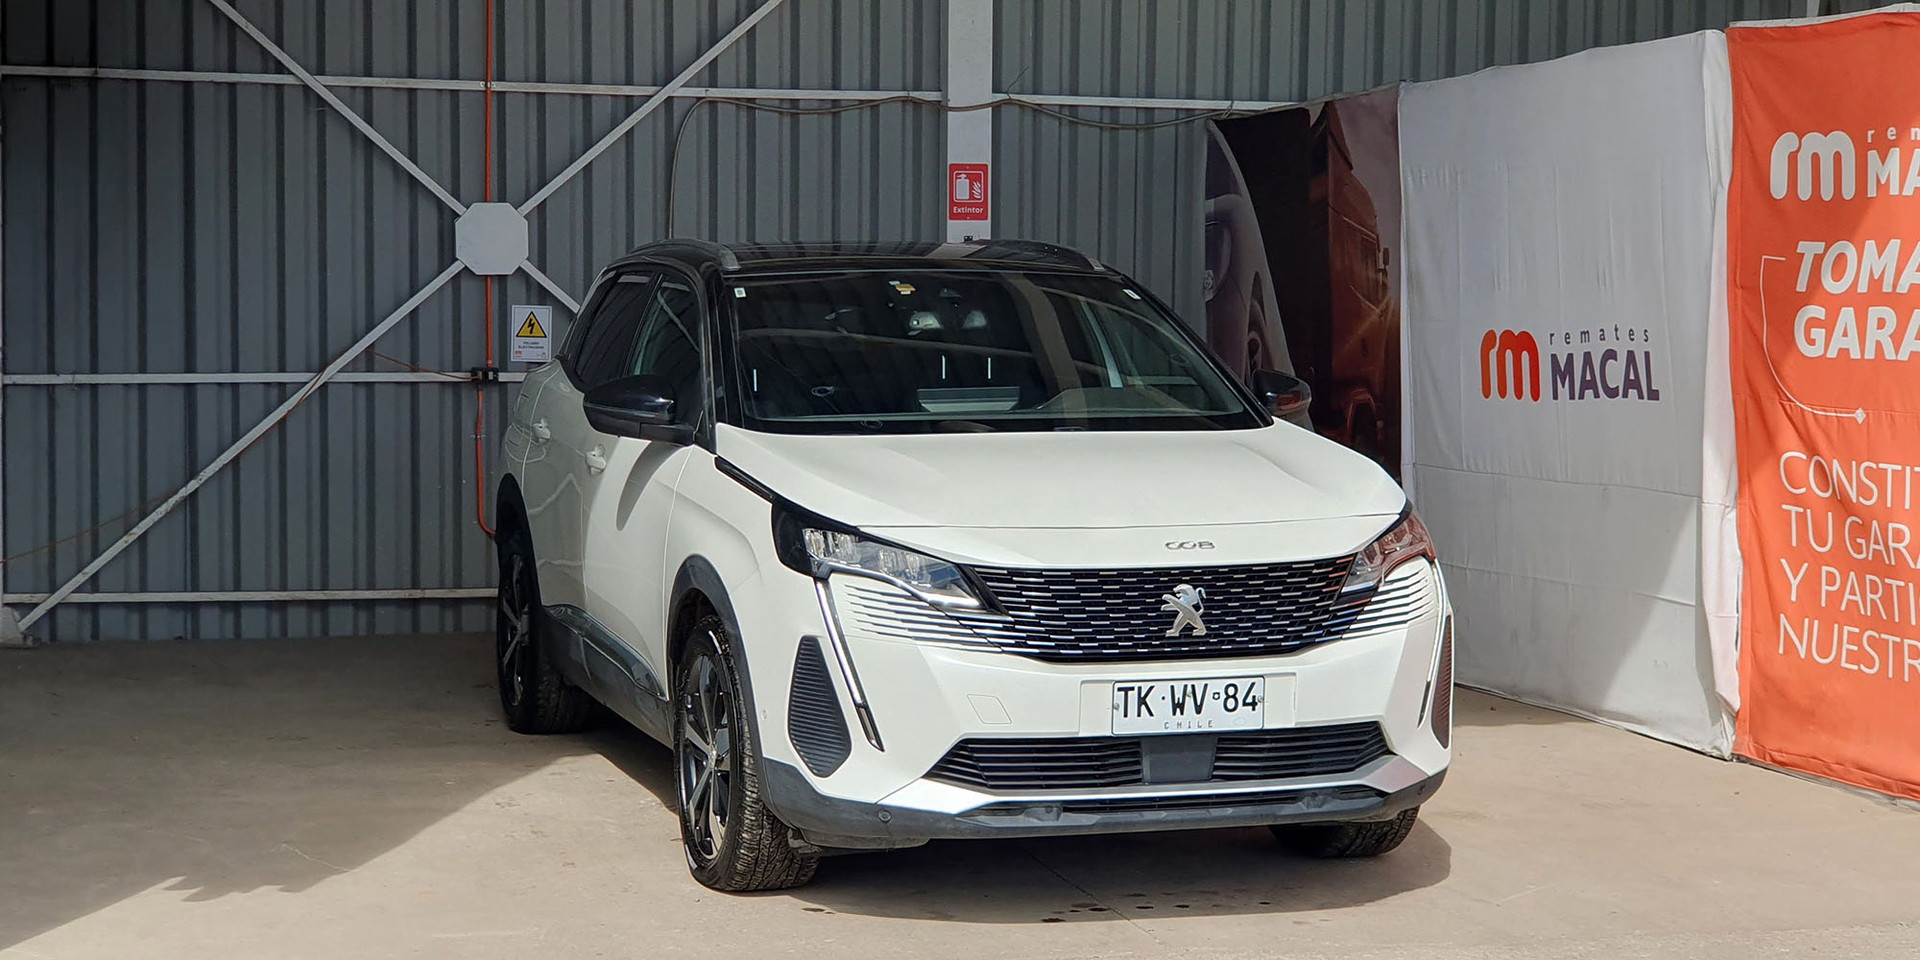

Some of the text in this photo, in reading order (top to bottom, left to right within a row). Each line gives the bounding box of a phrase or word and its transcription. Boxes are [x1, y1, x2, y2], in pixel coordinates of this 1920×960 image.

[1770, 131, 1855, 200] rm
[1867, 147, 1920, 197] MA
[953, 206, 983, 214] Extintor
[1795, 239, 1920, 294] TOMA
[1550, 323, 1649, 345] remates
[1794, 304, 1920, 361] GARA
[1480, 329, 1540, 402] rm
[1550, 348, 1660, 401] MACAL
[1779, 451, 1920, 509] CONSTI
[1781, 504, 1920, 568] TU GAR
[1780, 558, 1920, 626] Y PARTI
[1778, 613, 1920, 682] NUESTR
[1164, 720, 1214, 730] CHILE
